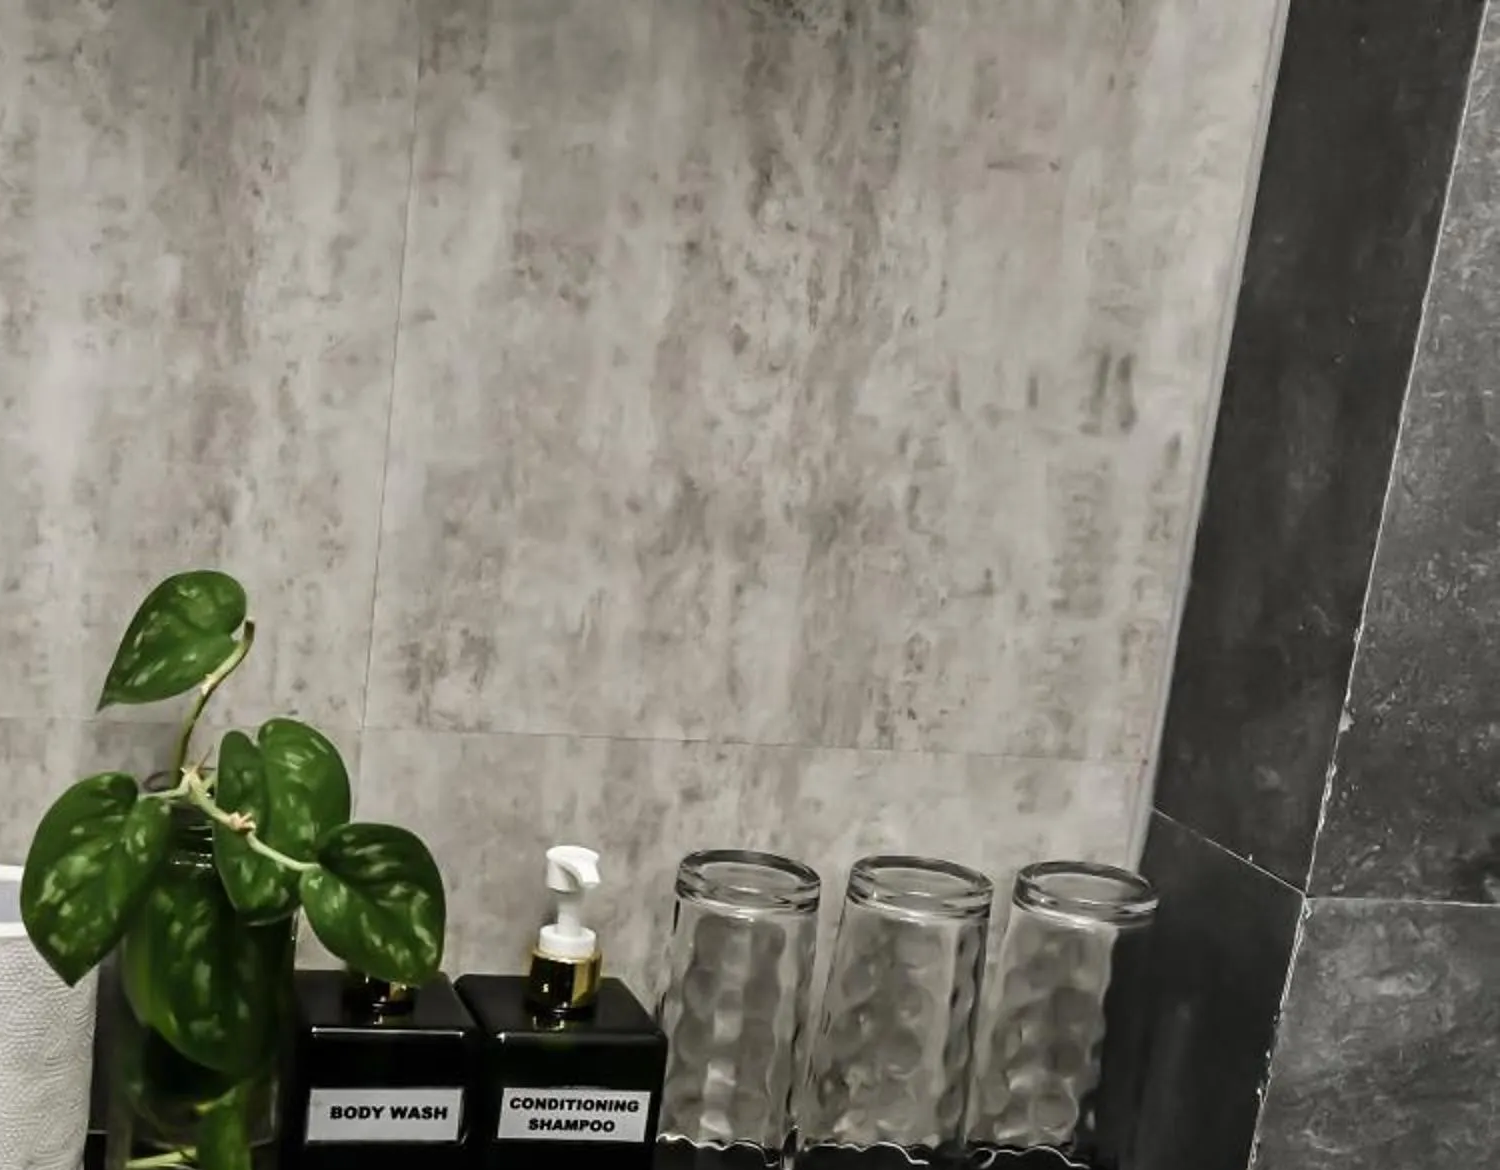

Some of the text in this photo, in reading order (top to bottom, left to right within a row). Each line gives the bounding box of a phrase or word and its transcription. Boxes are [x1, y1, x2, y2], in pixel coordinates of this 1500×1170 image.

[329, 1105, 449, 1120] BODY WASH
[509, 1097, 640, 1113] CONDITIONING
[528, 1117, 616, 1133] SHAMPOO
